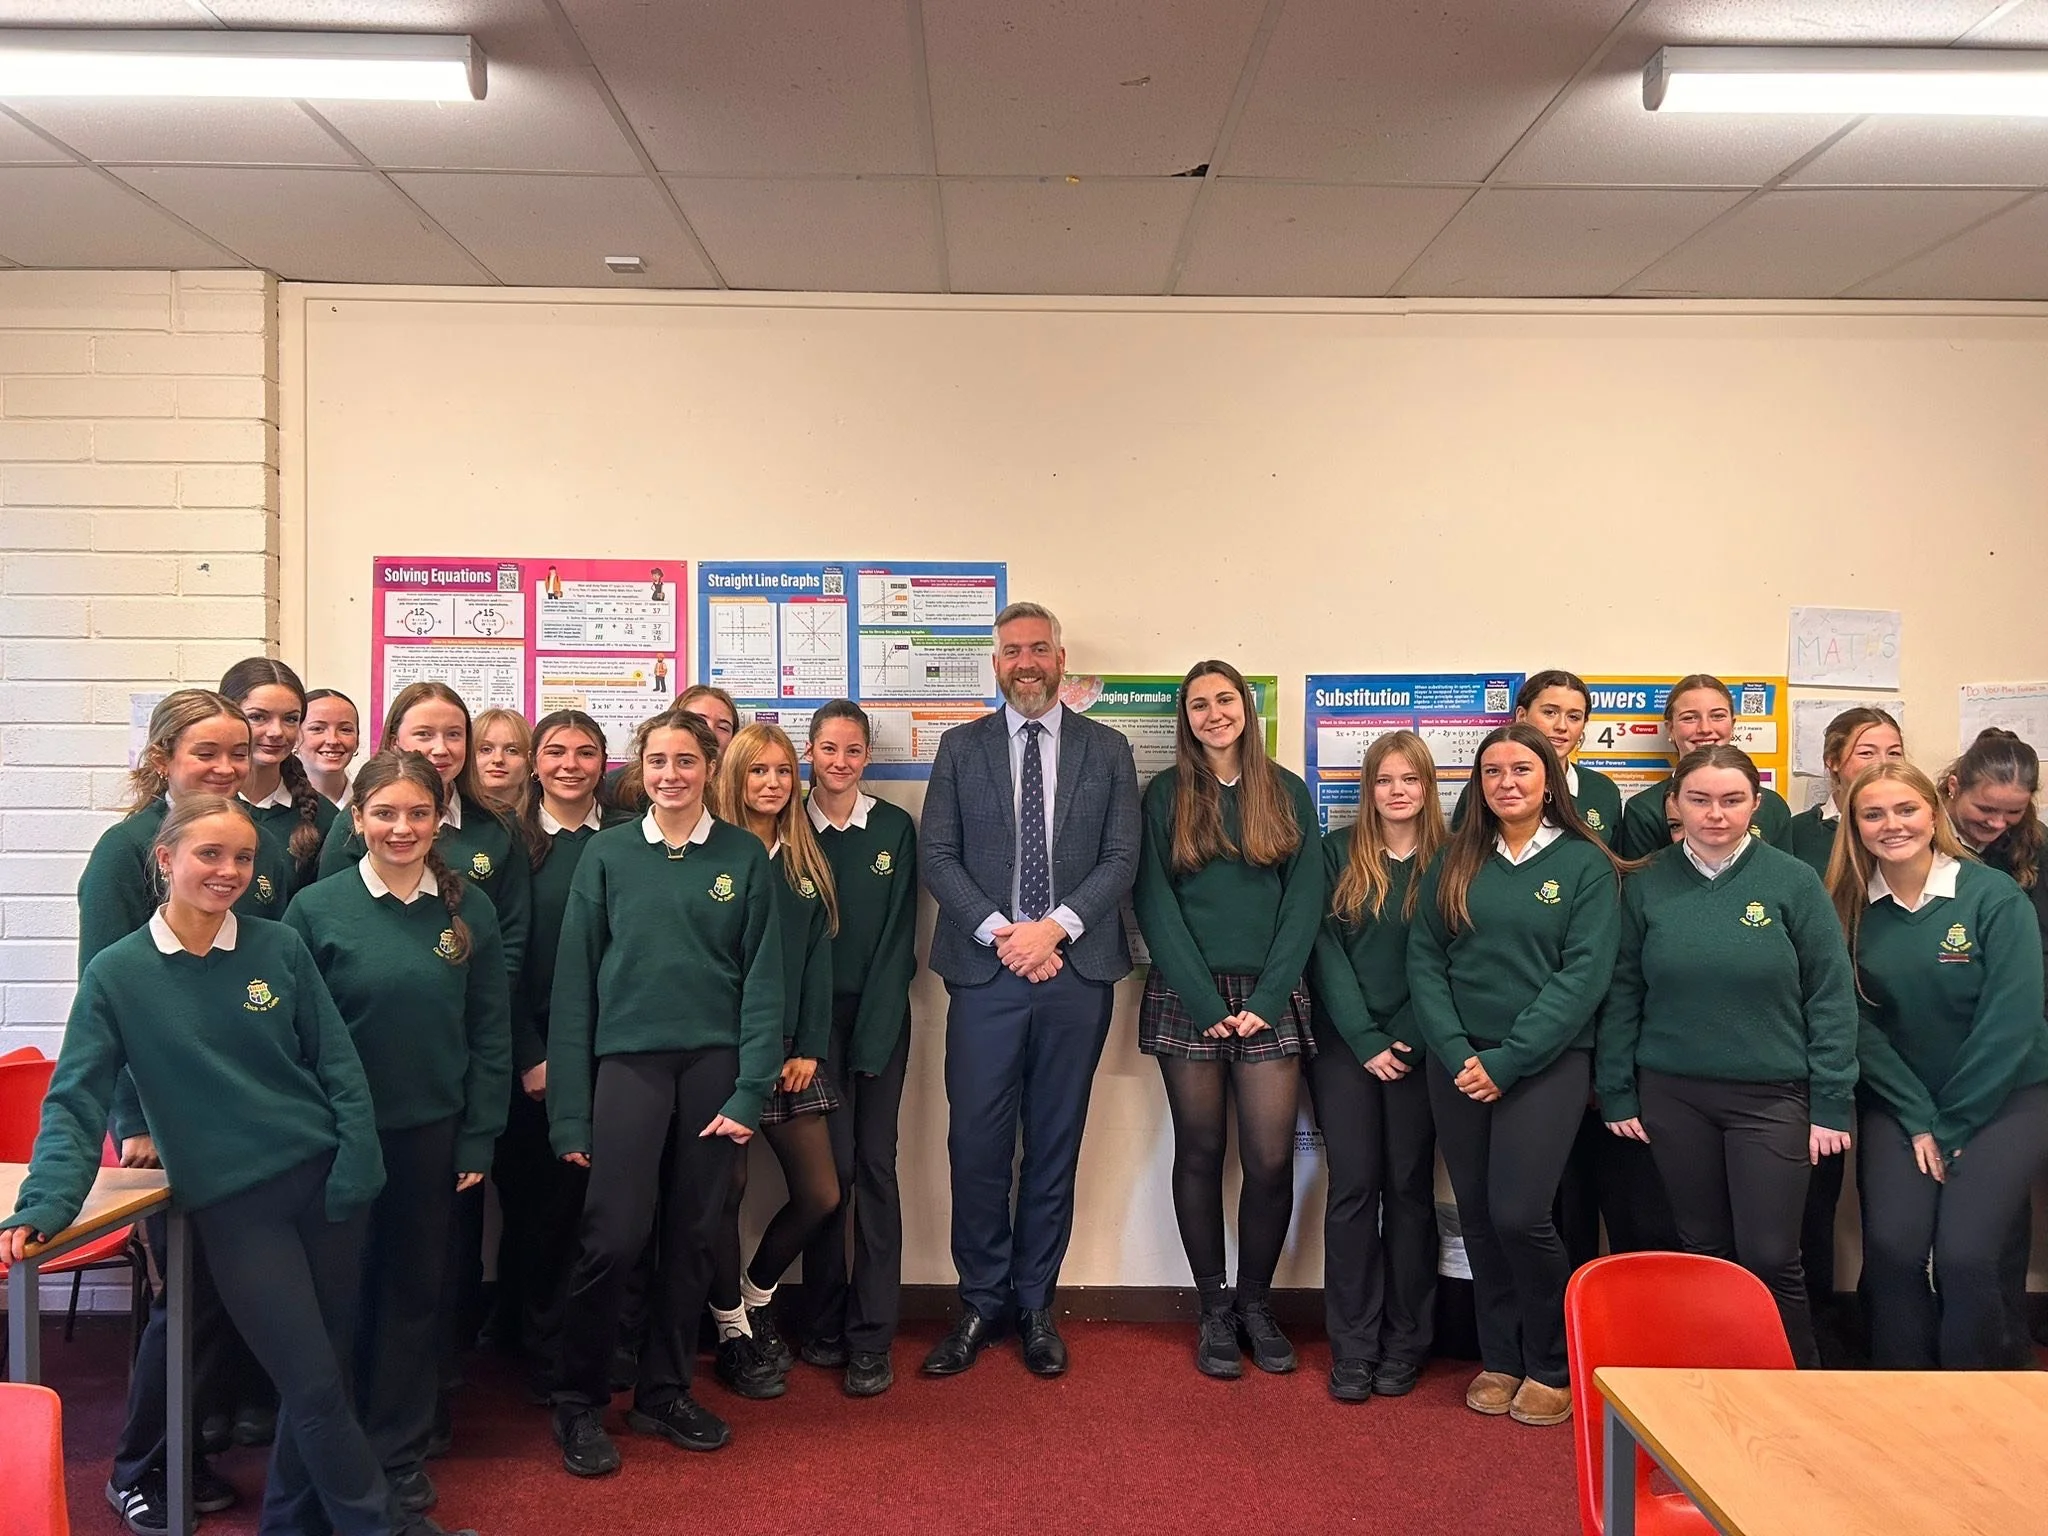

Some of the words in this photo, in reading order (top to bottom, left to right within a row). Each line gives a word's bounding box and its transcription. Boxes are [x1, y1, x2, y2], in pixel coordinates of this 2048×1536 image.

[385, 568, 428, 585] Solving
[432, 568, 491, 585] Equations
[708, 573, 753, 589] Straight
[755, 574, 778, 587] Line
[781, 574, 819, 589] Graphs
[1098, 691, 1128, 704] anging
[1130, 692, 1172, 702] Formulae
[1316, 688, 1410, 706] Substitution
[1590, 691, 1646, 708] owers
[1597, 727, 1614, 748] 4
[1616, 723, 1626, 736] 3
[1746, 733, 1752, 742] 4
